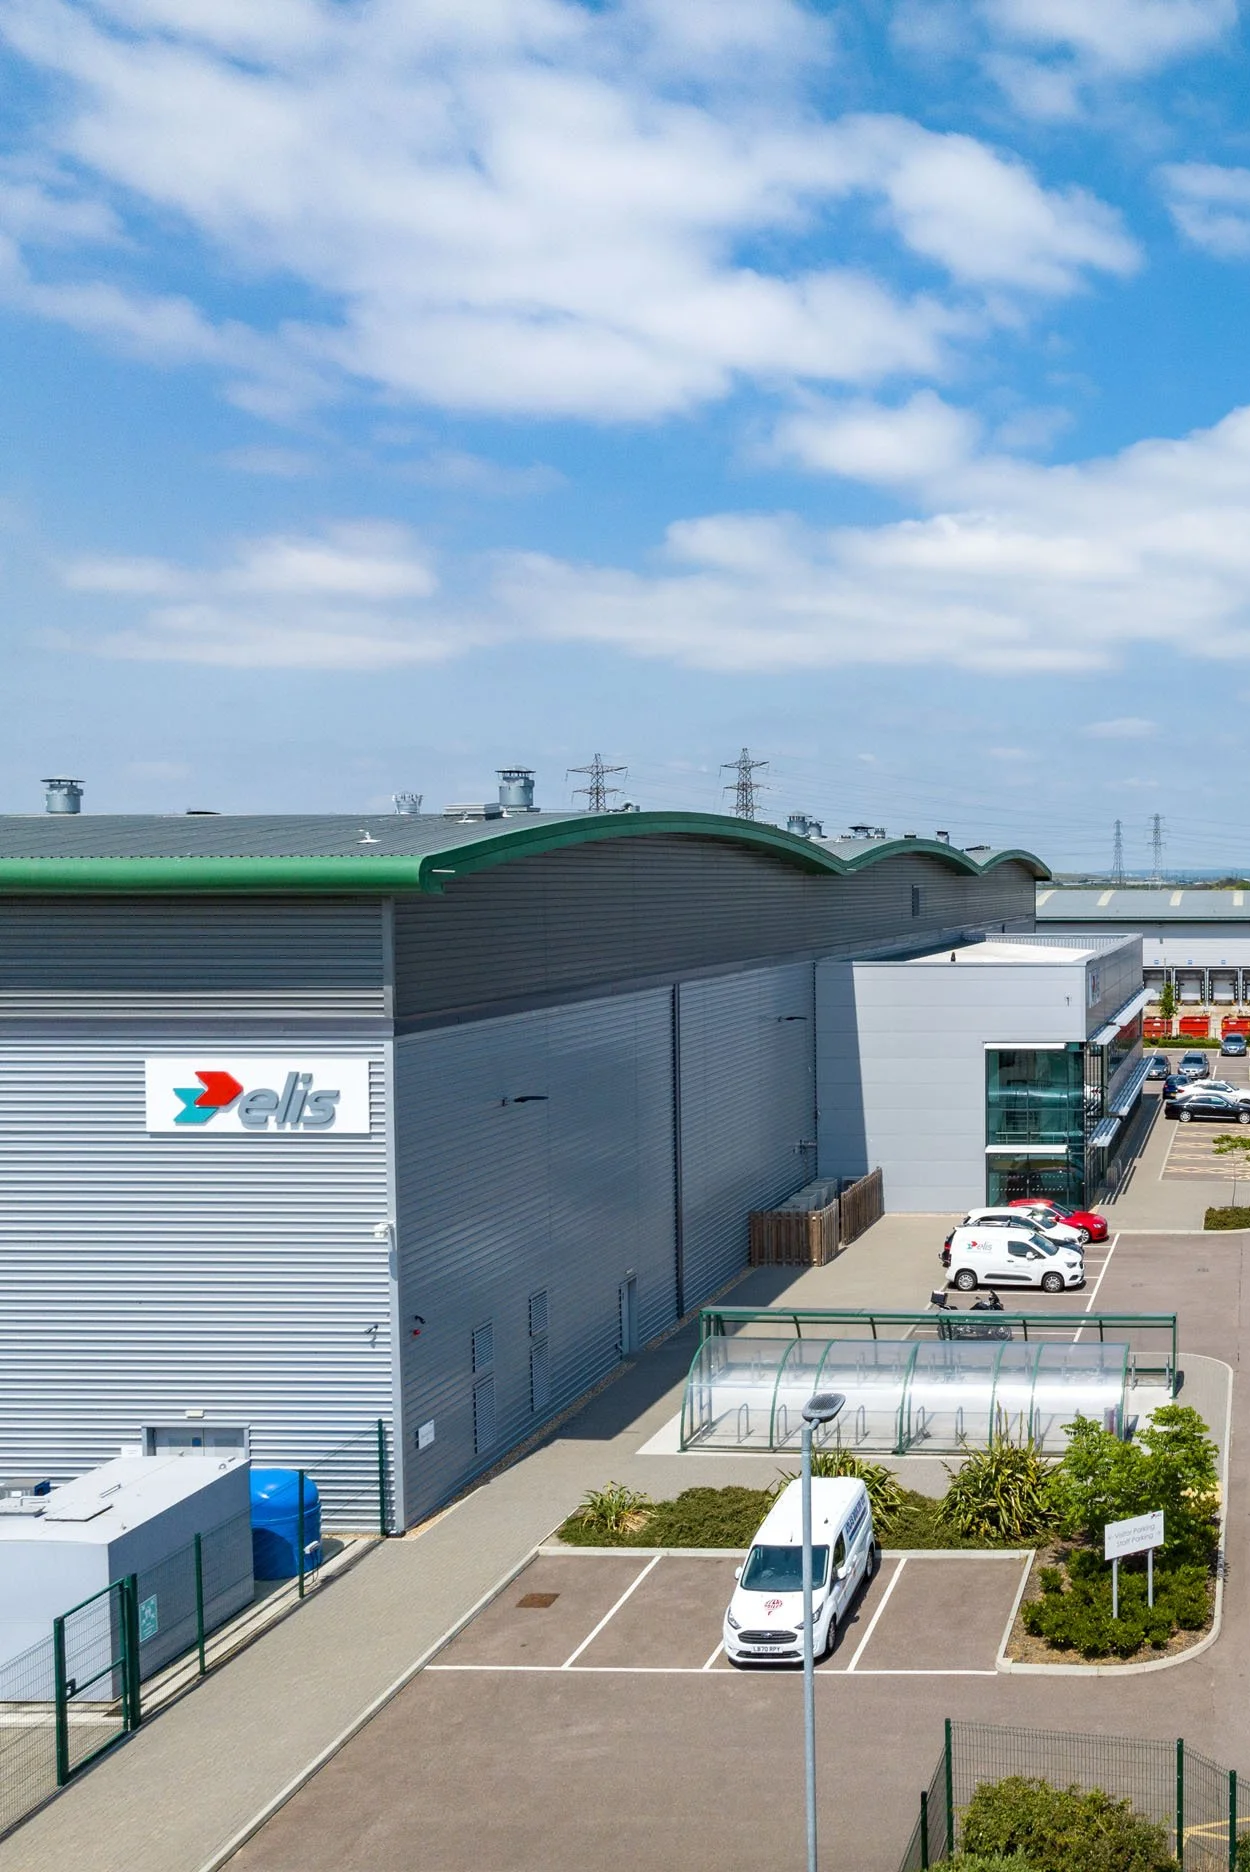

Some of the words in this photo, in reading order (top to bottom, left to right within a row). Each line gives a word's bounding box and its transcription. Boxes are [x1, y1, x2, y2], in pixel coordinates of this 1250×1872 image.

[238, 1071, 340, 1127] elis
[977, 1241, 992, 1251] elis
[1133, 1524, 1155, 1534] Parking
[1131, 1533, 1154, 1543] Parking
